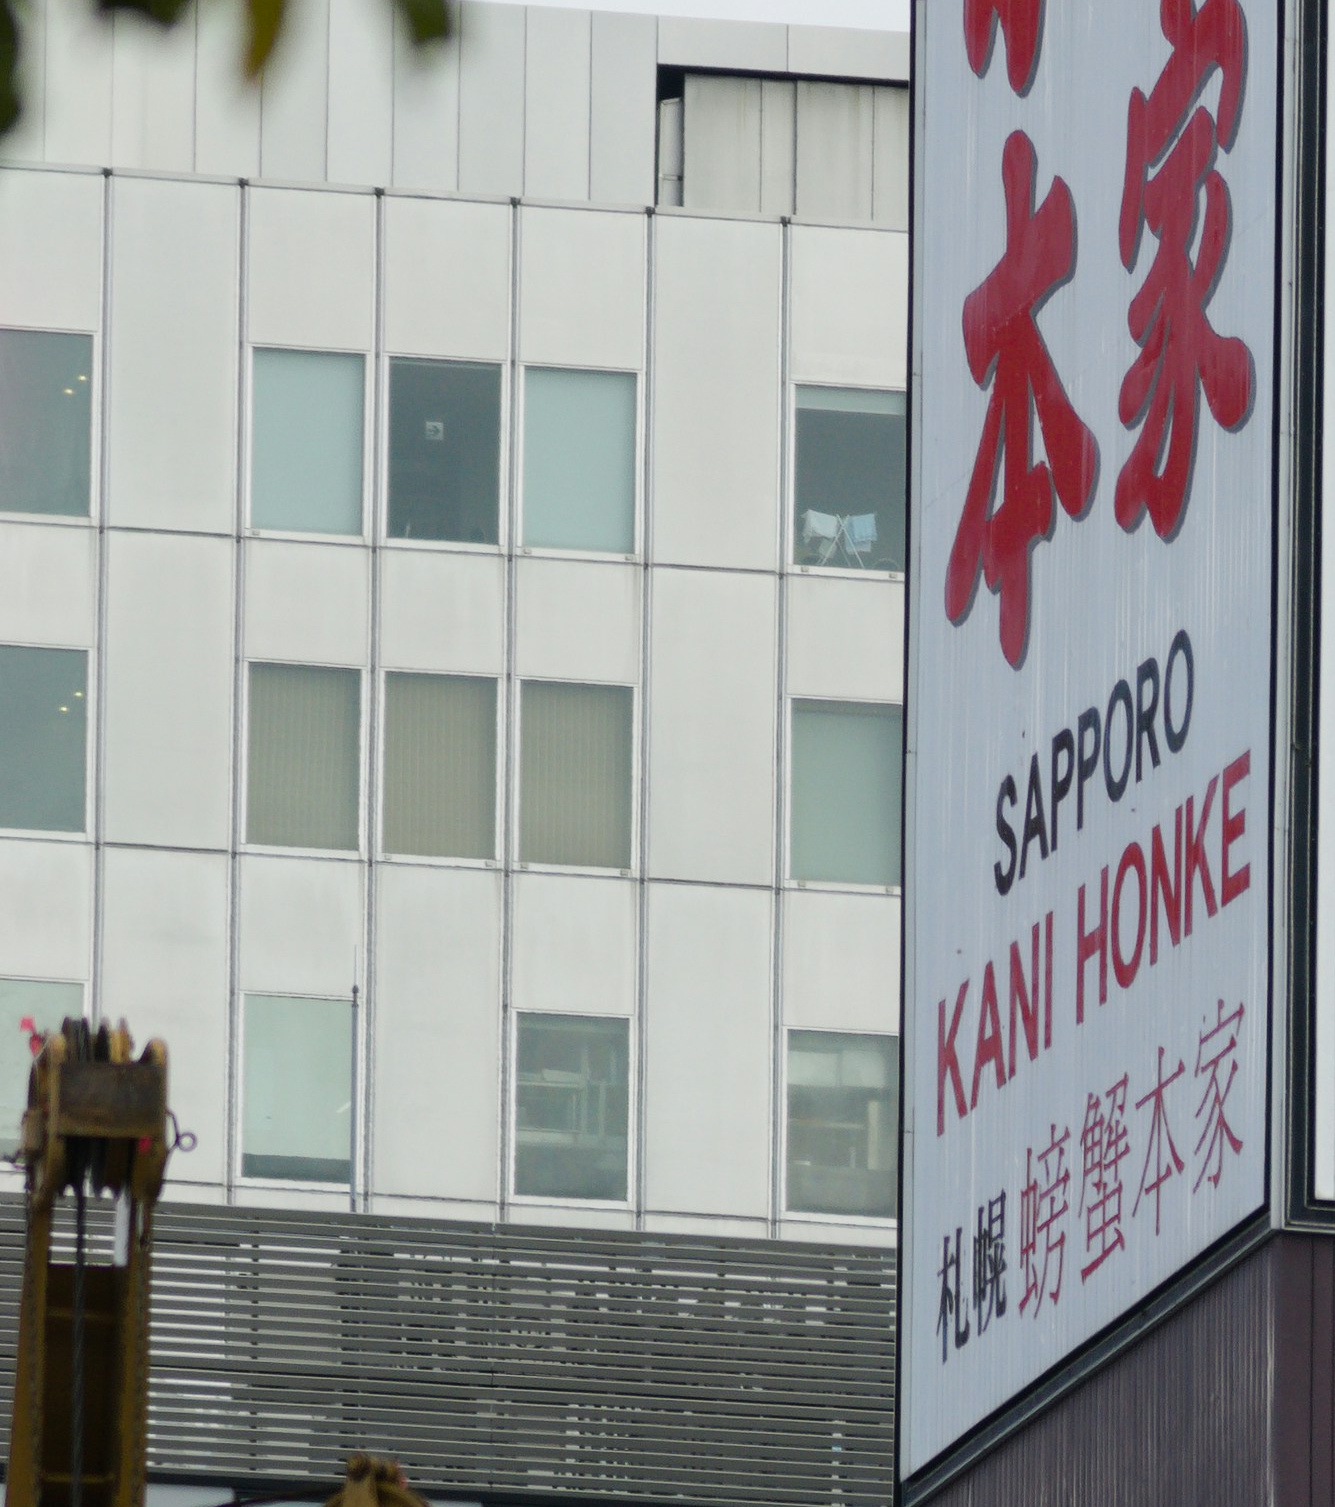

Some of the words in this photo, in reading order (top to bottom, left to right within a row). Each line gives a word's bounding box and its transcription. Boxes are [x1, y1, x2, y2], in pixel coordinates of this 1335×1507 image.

[993, 629, 1194, 896] SAPPORO
[936, 910, 1053, 1137] KANI
[1075, 749, 1252, 1026] HONKE
